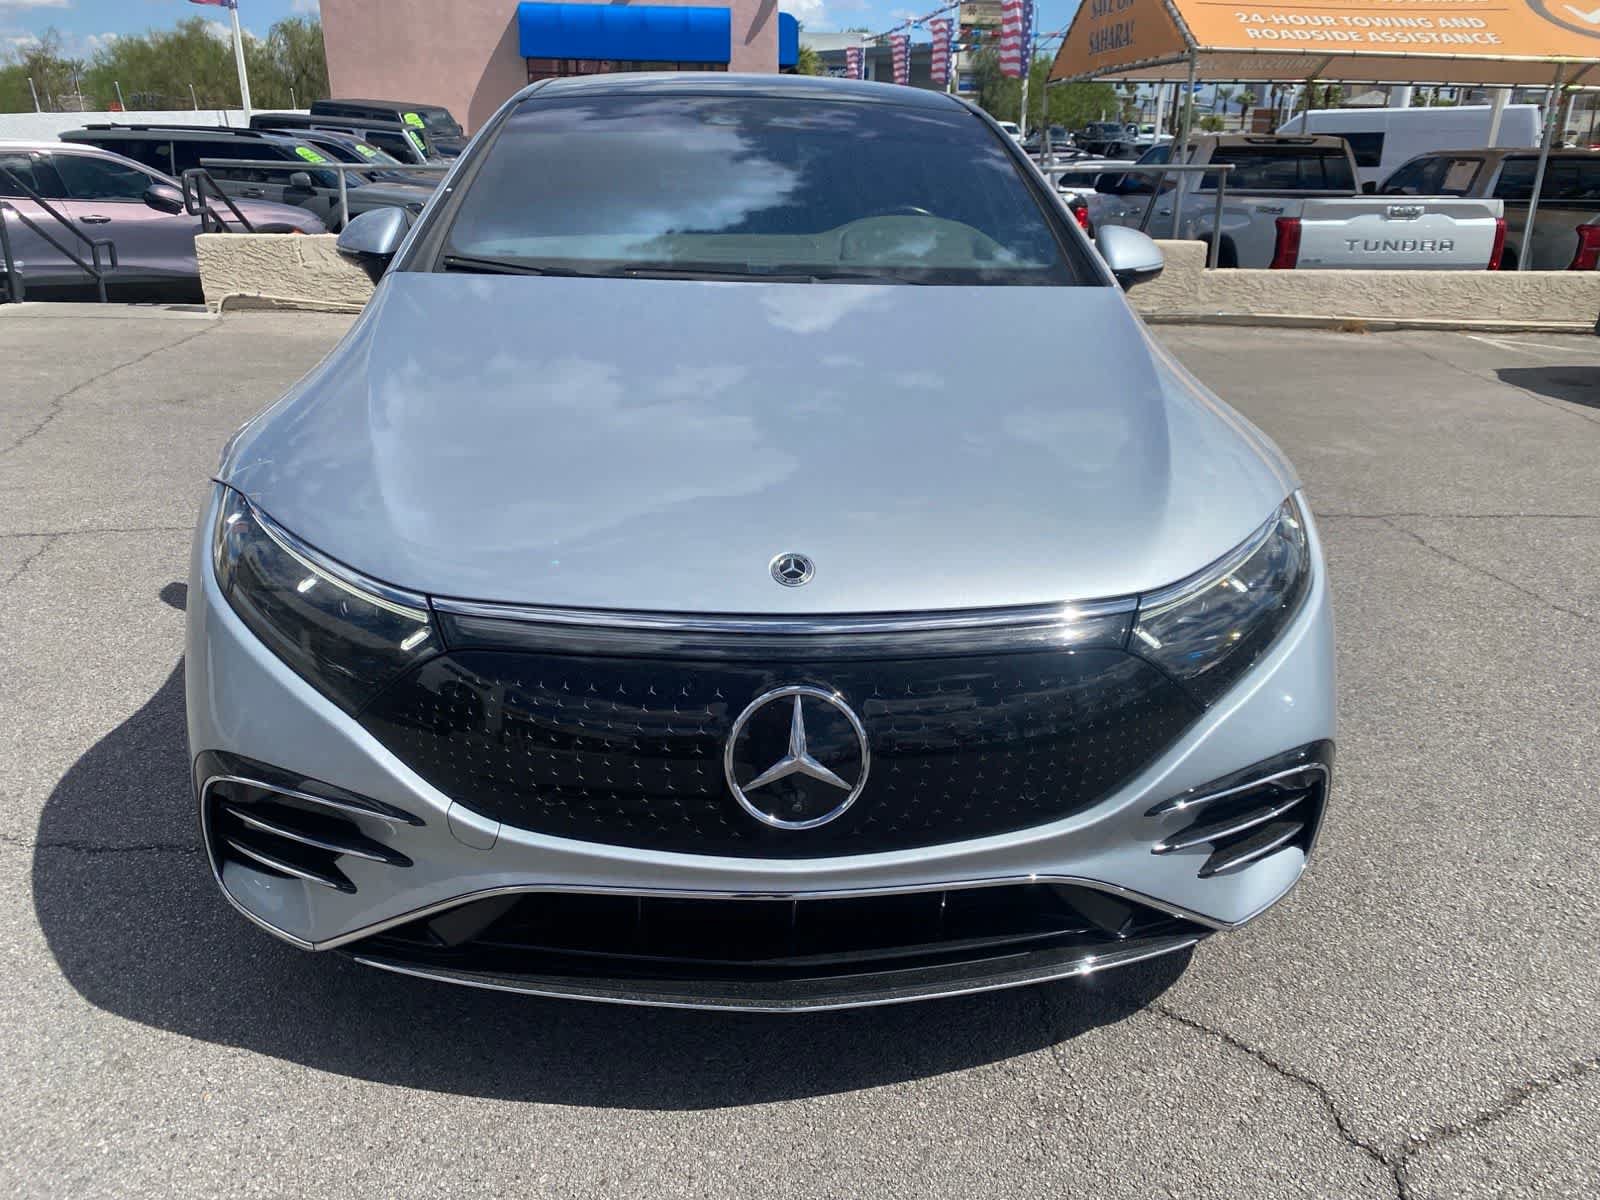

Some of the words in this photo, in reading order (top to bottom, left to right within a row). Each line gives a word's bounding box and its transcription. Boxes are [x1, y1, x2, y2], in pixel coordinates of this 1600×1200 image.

[1234, 12, 1338, 25] 24-HOUR
[1340, 15, 1434, 28] TOWING
[1437, 17, 1487, 28] AND
[1245, 28, 1363, 41] ROADSIDE
[1367, 31, 1503, 44] ASSISTANCE
[1343, 239, 1455, 252] TUNDRA
